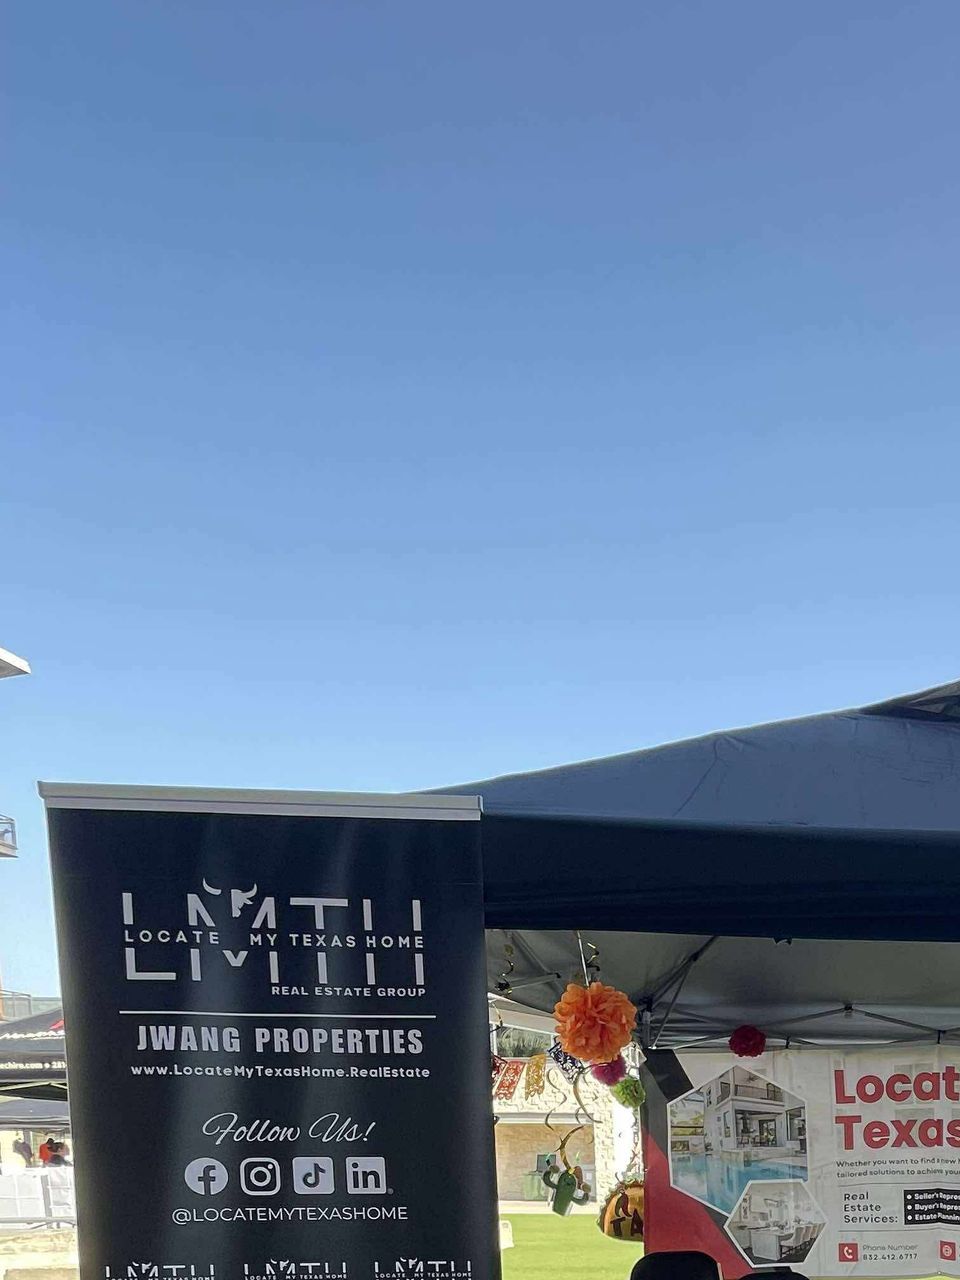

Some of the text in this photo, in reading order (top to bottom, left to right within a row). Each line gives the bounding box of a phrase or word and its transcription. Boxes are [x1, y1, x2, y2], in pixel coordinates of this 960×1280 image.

[124, 930, 425, 949] LOCATE MY TEXAS HOME
[272, 986, 426, 998] REAL ESTATE GROUP
[136, 1025, 424, 1055] JWANG PROPERTIES
[130, 1065, 430, 1079] www.LocateMyTexasHome.RealEstate
[202, 1112, 376, 1146] Follow Us!
[836, 1160, 871, 1168] Whether
[873, 1160, 887, 1169] you
[837, 1170, 868, 1178] tailored
[869, 1168, 905, 1176] solutions
[843, 1192, 869, 1201] Real
[914, 1192, 939, 1201] Seller's
[843, 1203, 881, 1212] Estate
[914, 1202, 939, 1211] Buyer's
[172, 1205, 409, 1226] @LOCATEMYTEXASHOME
[843, 1214, 898, 1224] Services:
[914, 1213, 938, 1221] Estate
